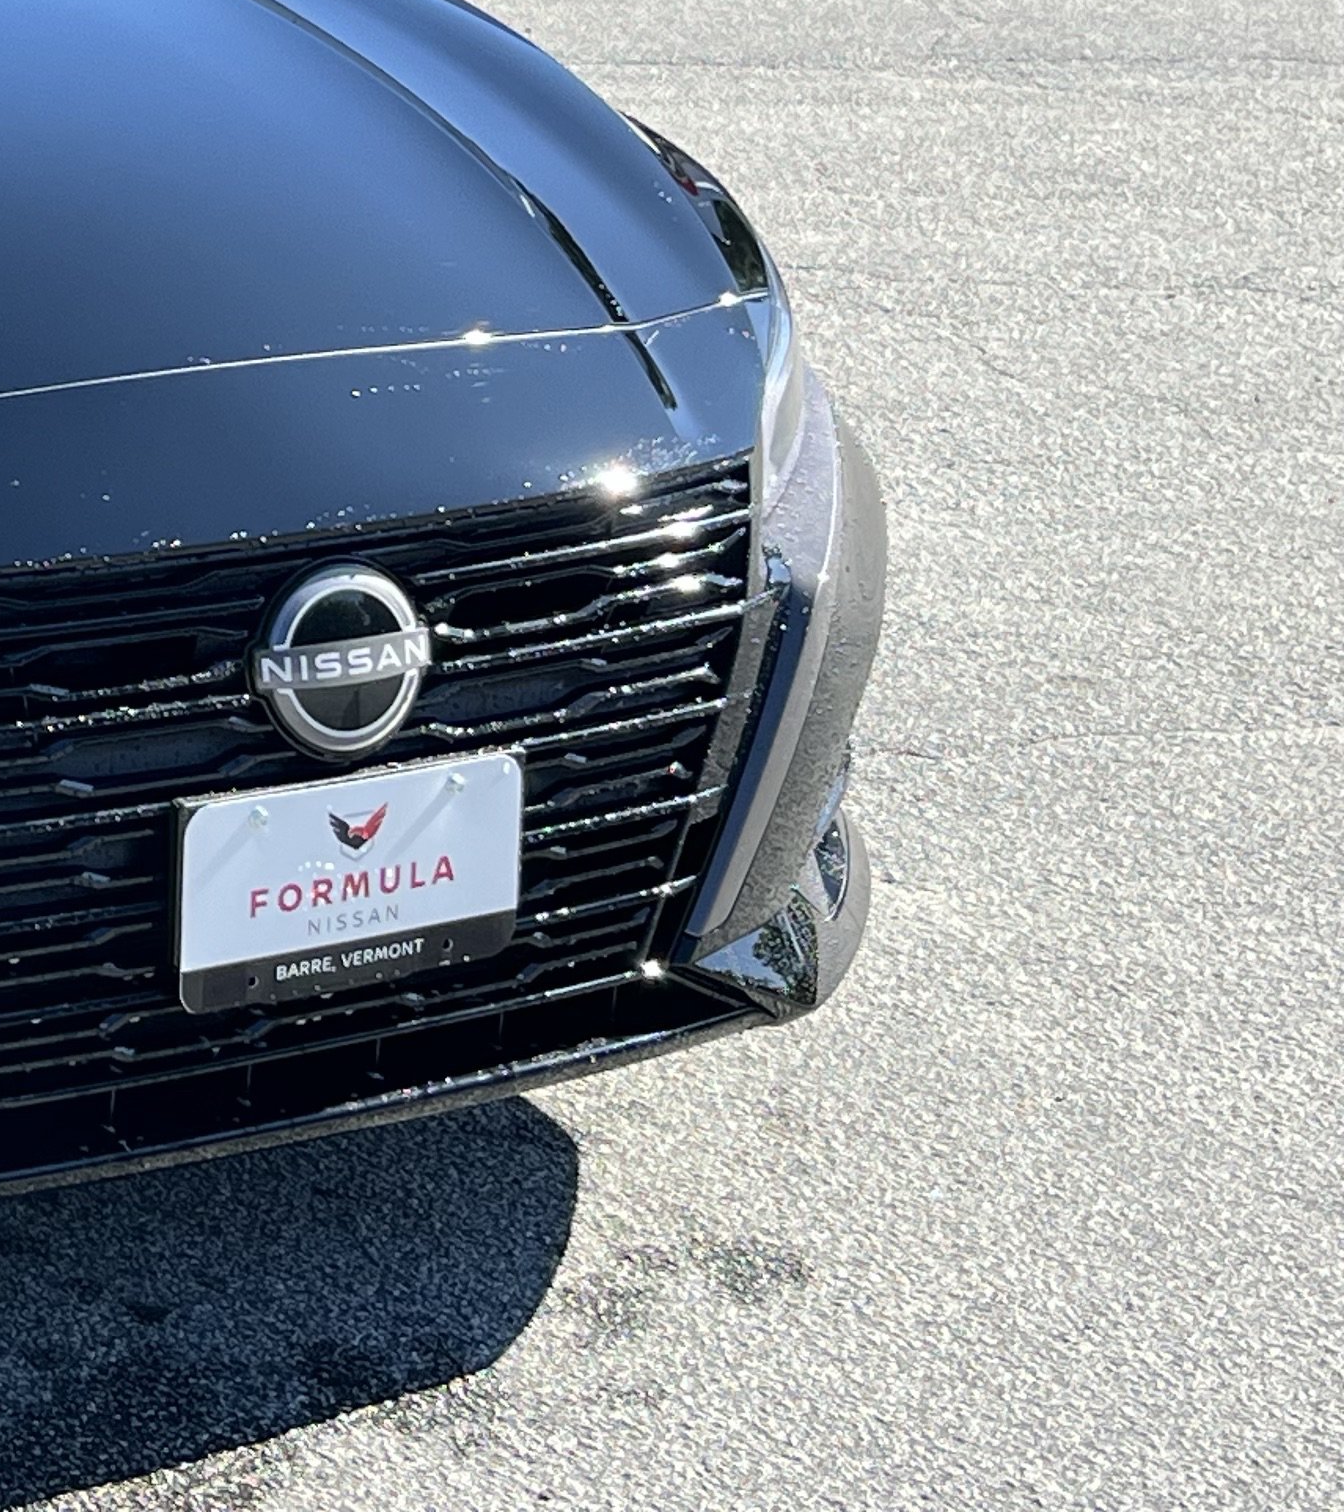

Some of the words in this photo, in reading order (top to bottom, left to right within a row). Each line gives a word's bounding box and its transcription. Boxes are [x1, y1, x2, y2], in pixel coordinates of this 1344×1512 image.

[259, 634, 427, 683] NISSAN
[249, 855, 455, 918] FORMULA
[306, 904, 400, 936] NISSAN
[275, 956, 337, 982] BARRE,
[340, 937, 426, 969] VERMONT
